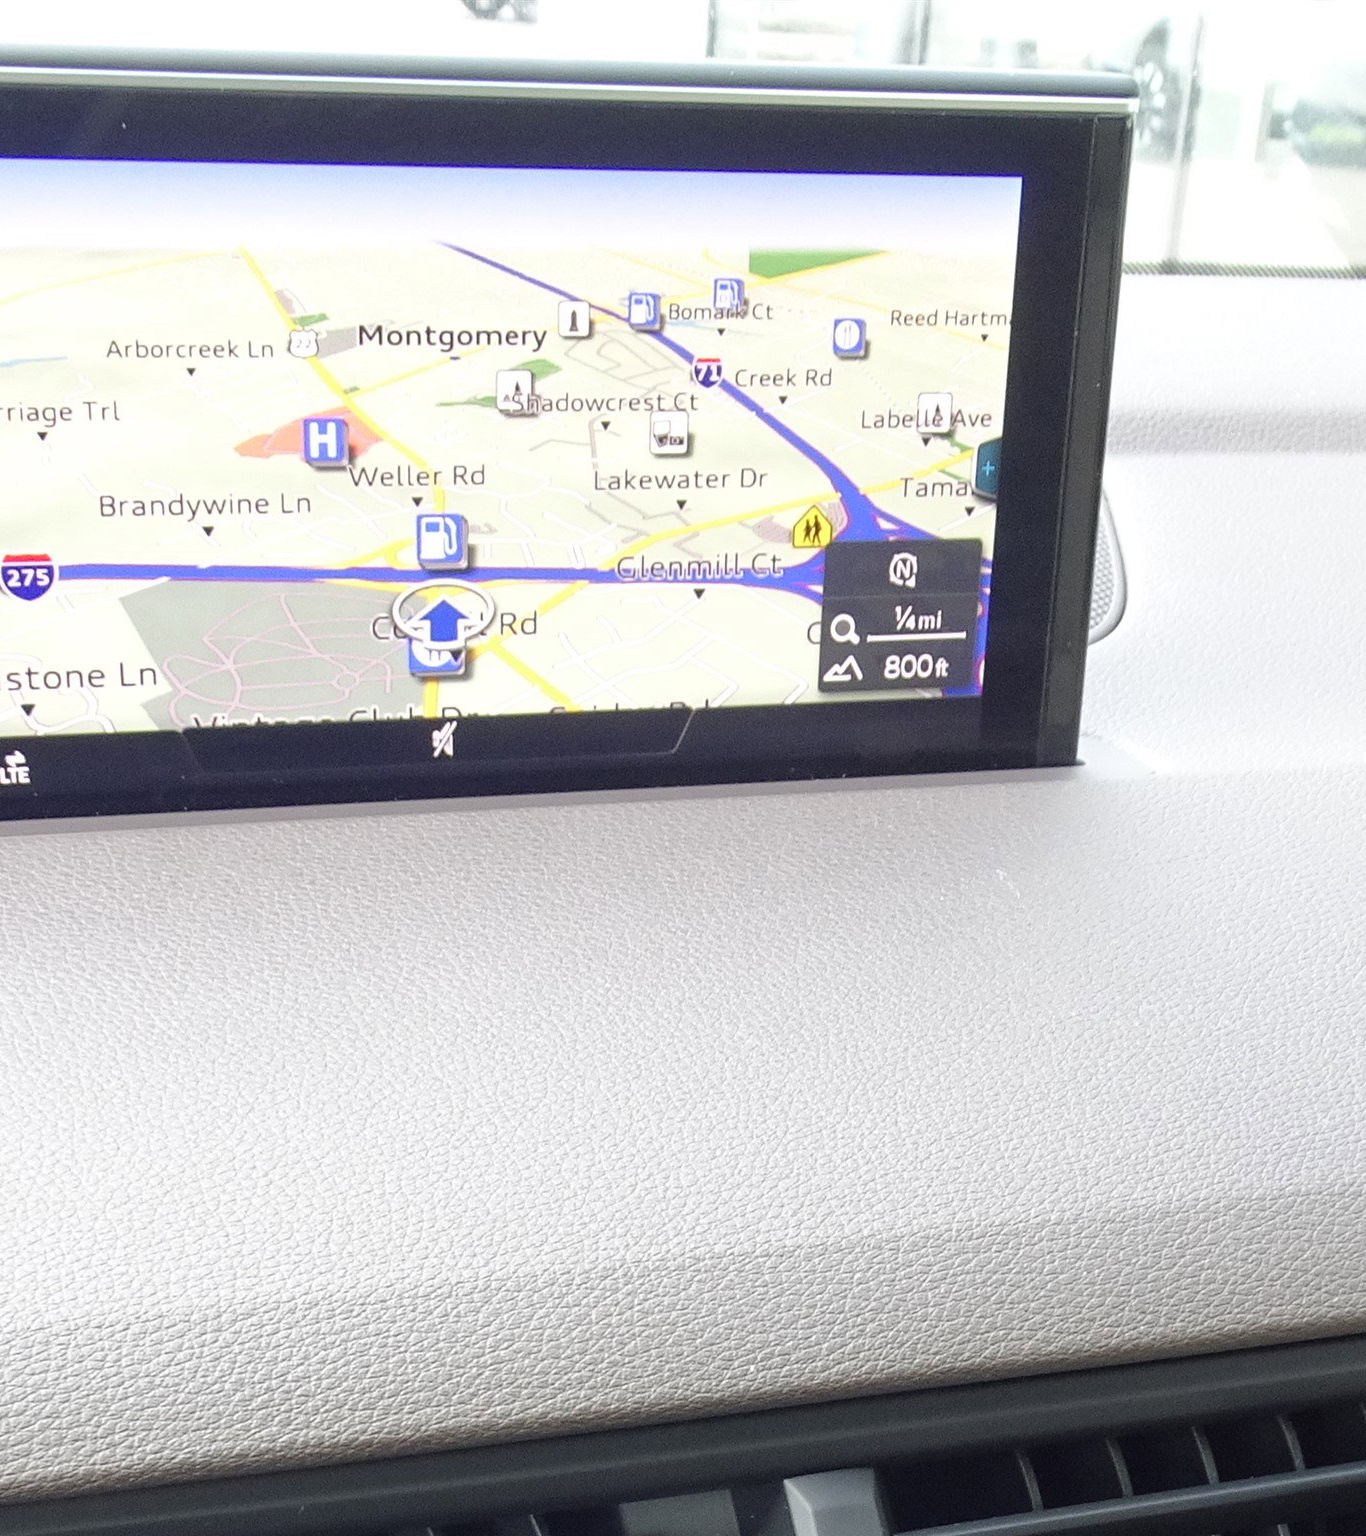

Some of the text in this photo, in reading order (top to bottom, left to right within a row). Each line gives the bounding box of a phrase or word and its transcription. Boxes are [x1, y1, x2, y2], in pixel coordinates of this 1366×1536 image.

[668, 302, 774, 320] Bomark Ct
[891, 309, 938, 327] Reed
[106, 338, 239, 359] Arborcreek
[247, 339, 275, 358] Ln
[357, 323, 547, 354] Montgomery
[696, 364, 720, 382] 71
[734, 367, 833, 387] Creek Rd
[83, 401, 121, 421] Trl
[512, 391, 699, 413] Shadowcrest Ct
[861, 408, 992, 429] Labelle Ave
[348, 464, 487, 488] Weller Rd
[593, 467, 769, 492] Lakewater Dr
[99, 493, 312, 523] Brandywine Ln
[615, 553, 783, 580] Glenmill Ct
[6, 568, 51, 588] 275
[499, 610, 538, 636] Rd
[119, 663, 159, 688] Ln
